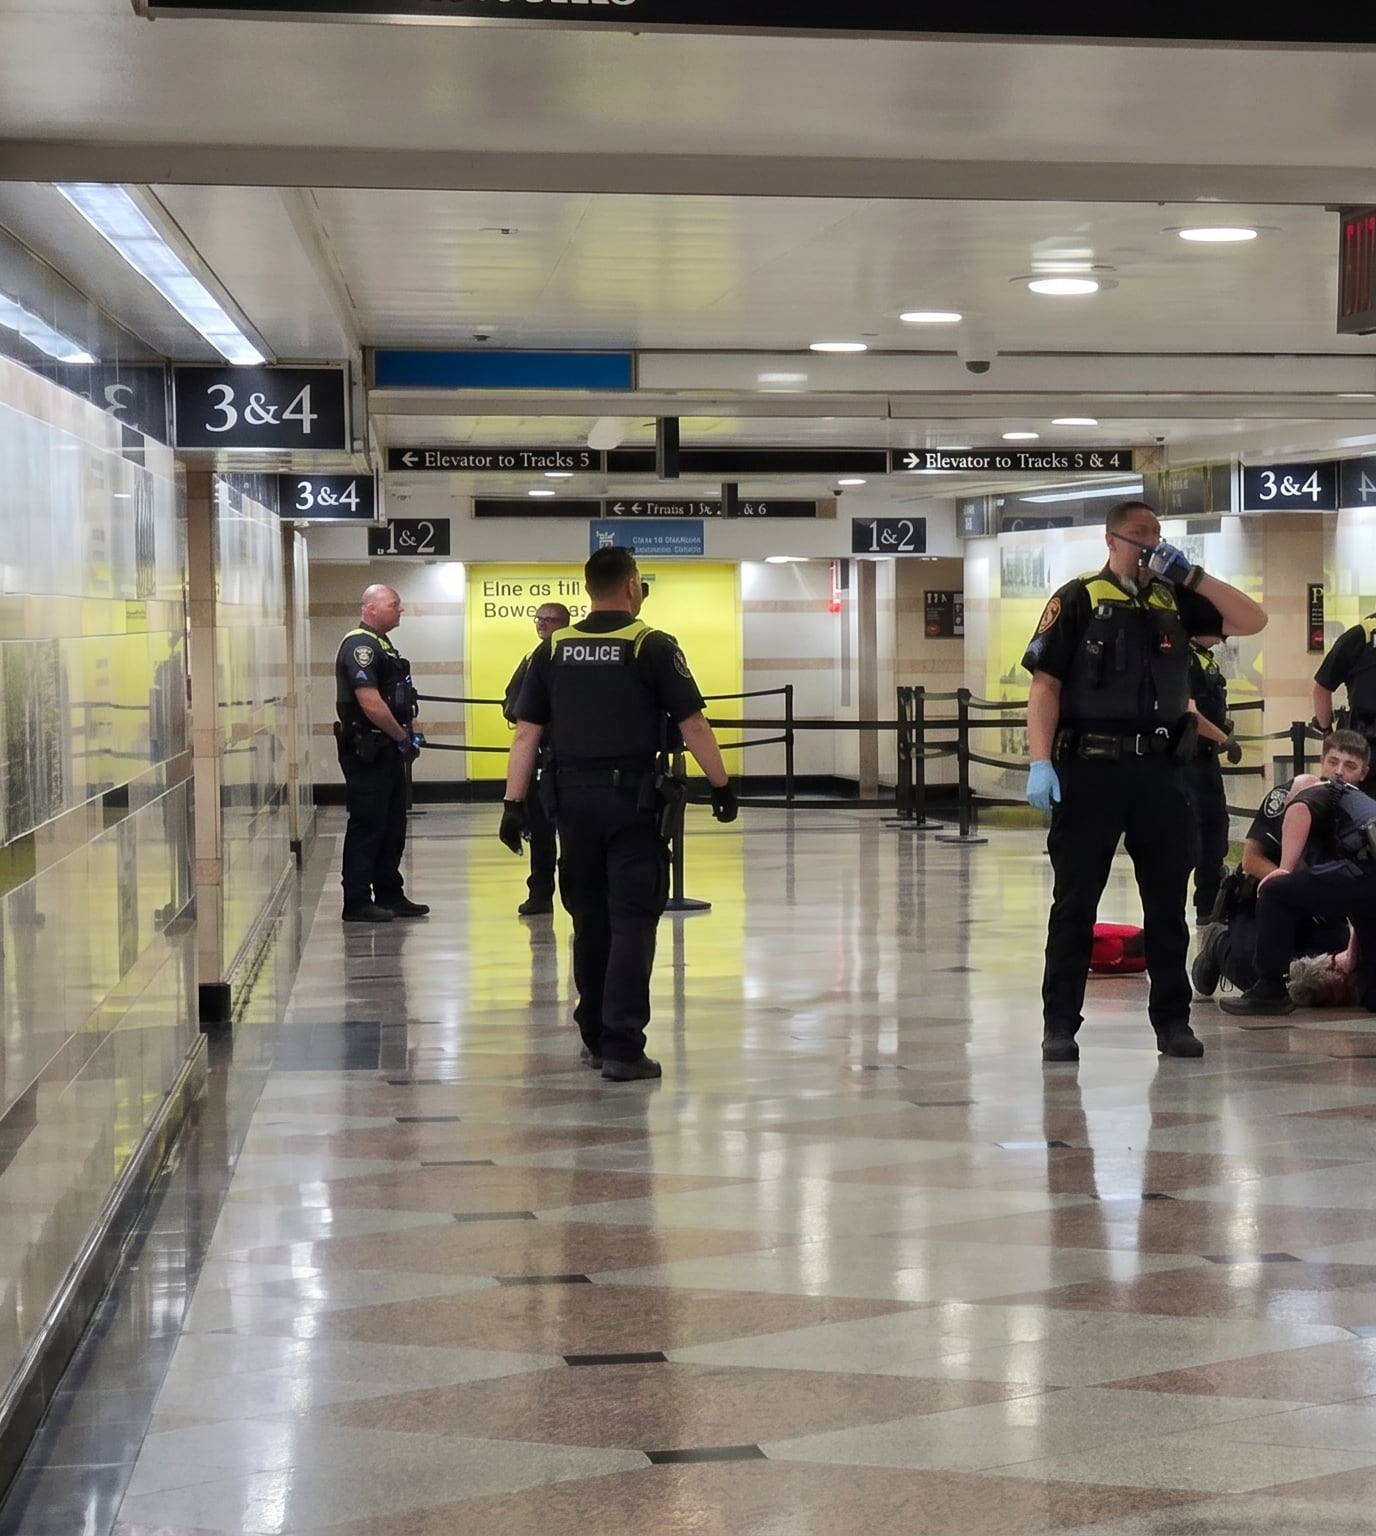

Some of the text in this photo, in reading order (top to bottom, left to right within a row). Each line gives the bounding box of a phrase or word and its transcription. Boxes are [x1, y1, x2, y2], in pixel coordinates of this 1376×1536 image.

[205, 383, 318, 434] 3&4
[424, 451, 493, 467] Elevator
[498, 455, 515, 467] to
[520, 451, 574, 467] Tracks
[925, 452, 991, 468] Elevator
[995, 455, 1011, 468] to
[1017, 452, 1068, 468] Tracks
[1089, 453, 1104, 468] &
[1110, 453, 1120, 468] 4
[295, 481, 360, 512] 3&4
[1259, 470, 1322, 502] 3&4
[386, 521, 435, 553] 1&2
[868, 519, 915, 551] 1&2
[529, 583, 551, 596] as
[484, 602, 588, 618] Bowe as
[563, 646, 621, 662] POLICE
